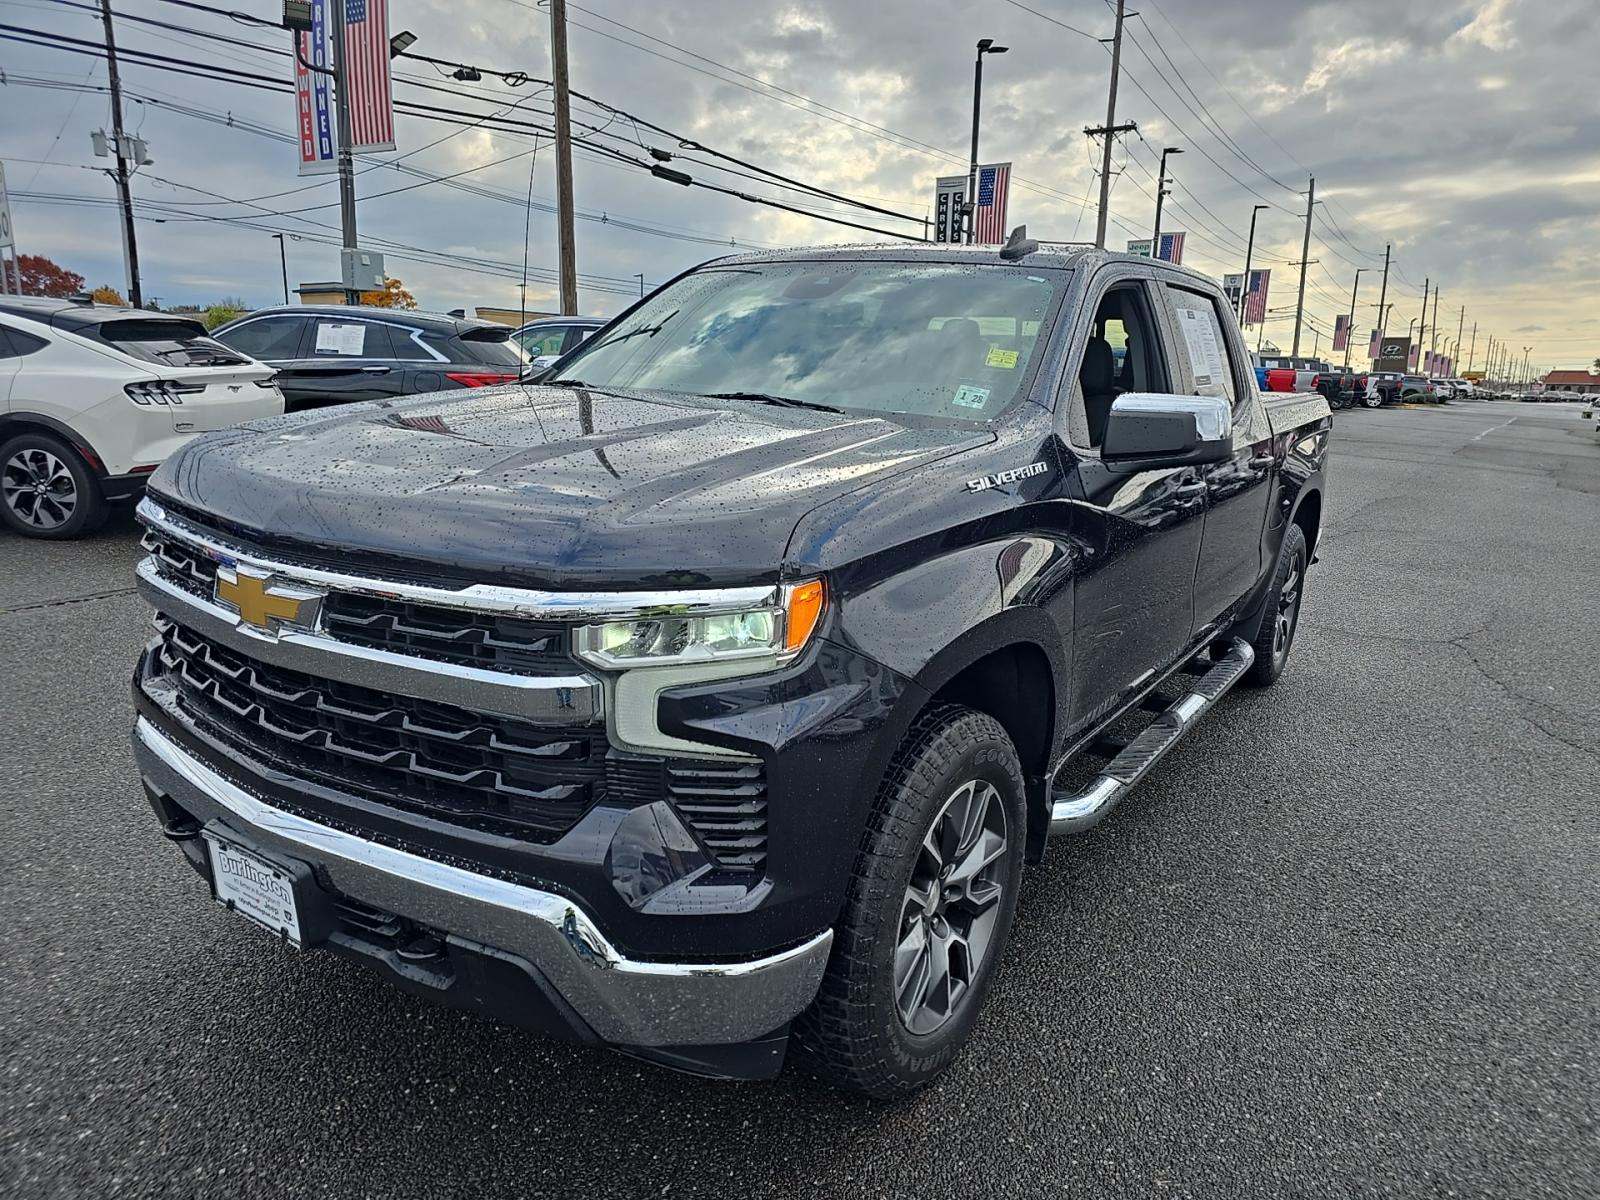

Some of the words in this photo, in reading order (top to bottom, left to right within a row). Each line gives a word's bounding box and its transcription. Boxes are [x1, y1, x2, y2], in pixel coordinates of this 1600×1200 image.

[959, 391, 967, 401] 1
[971, 394, 984, 404] 28
[967, 461, 1049, 494] SILVERADO
[219, 851, 291, 905] Burlington
